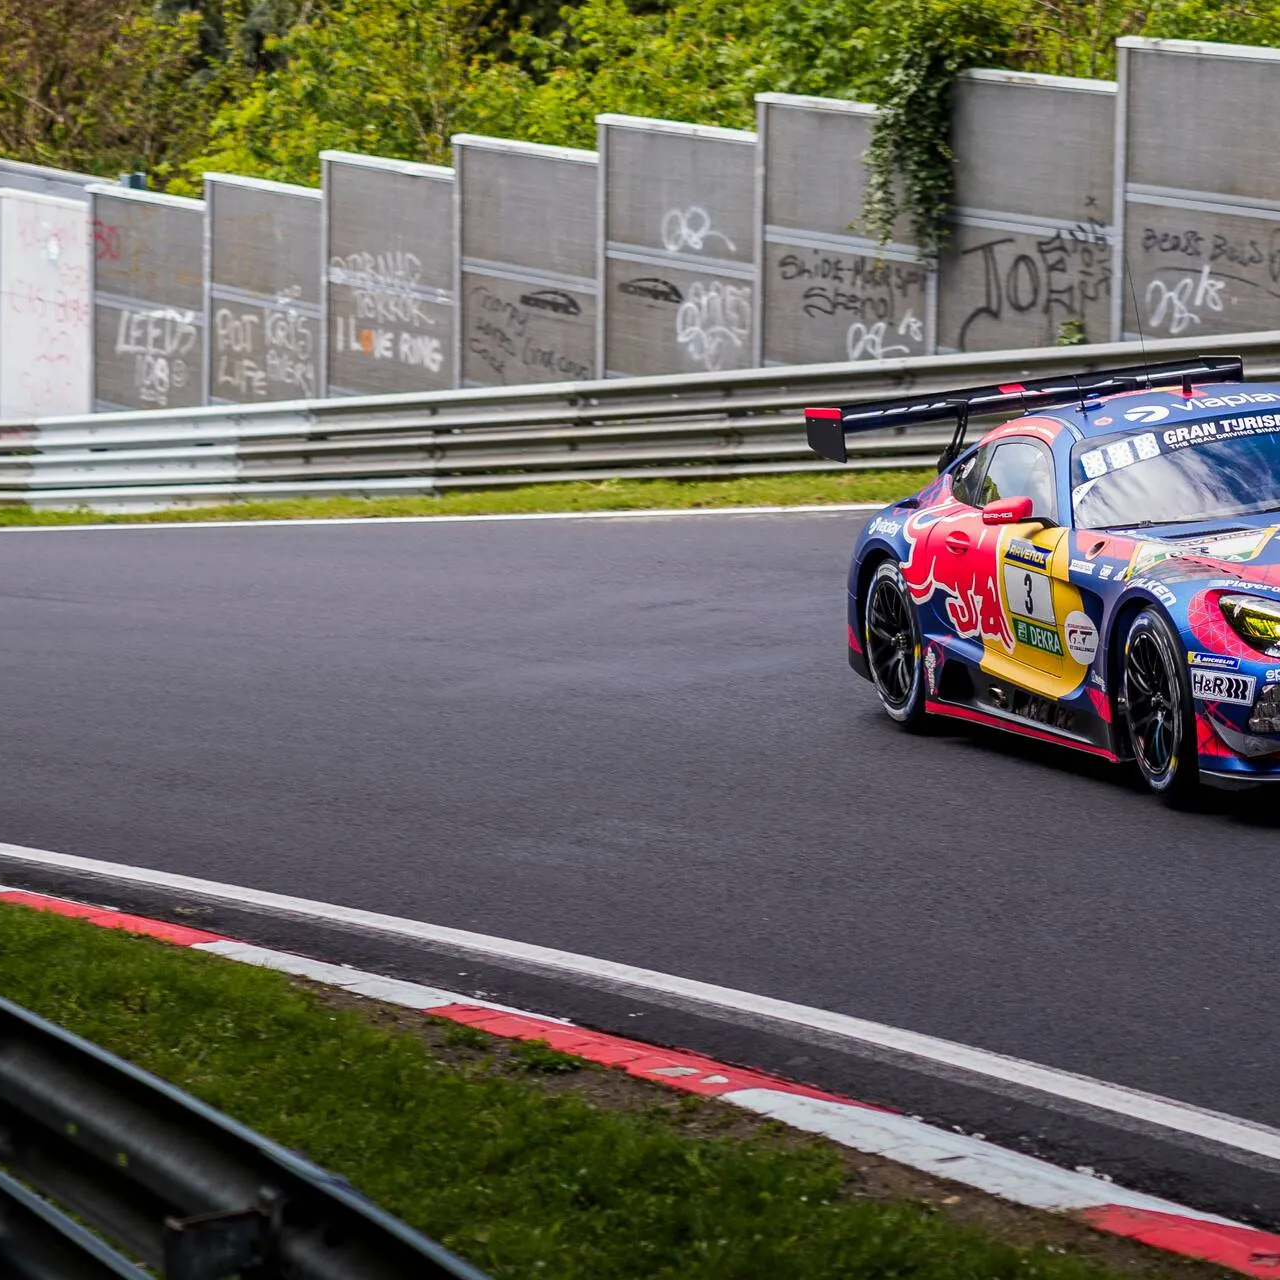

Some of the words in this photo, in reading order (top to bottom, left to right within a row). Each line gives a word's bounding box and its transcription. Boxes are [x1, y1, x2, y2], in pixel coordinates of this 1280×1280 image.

[1163, 422, 1217, 445] GRAN
[1169, 440, 1190, 450] THE
[1191, 435, 1216, 446] REAL
[1216, 429, 1255, 440] DRIVING
[1009, 543, 1047, 565] RAVENOL
[1023, 573, 1034, 615] 3
[1029, 625, 1063, 655] DEKRA
[1202, 656, 1235, 666] MICHELIN
[1193, 674, 1224, 696] H&R
